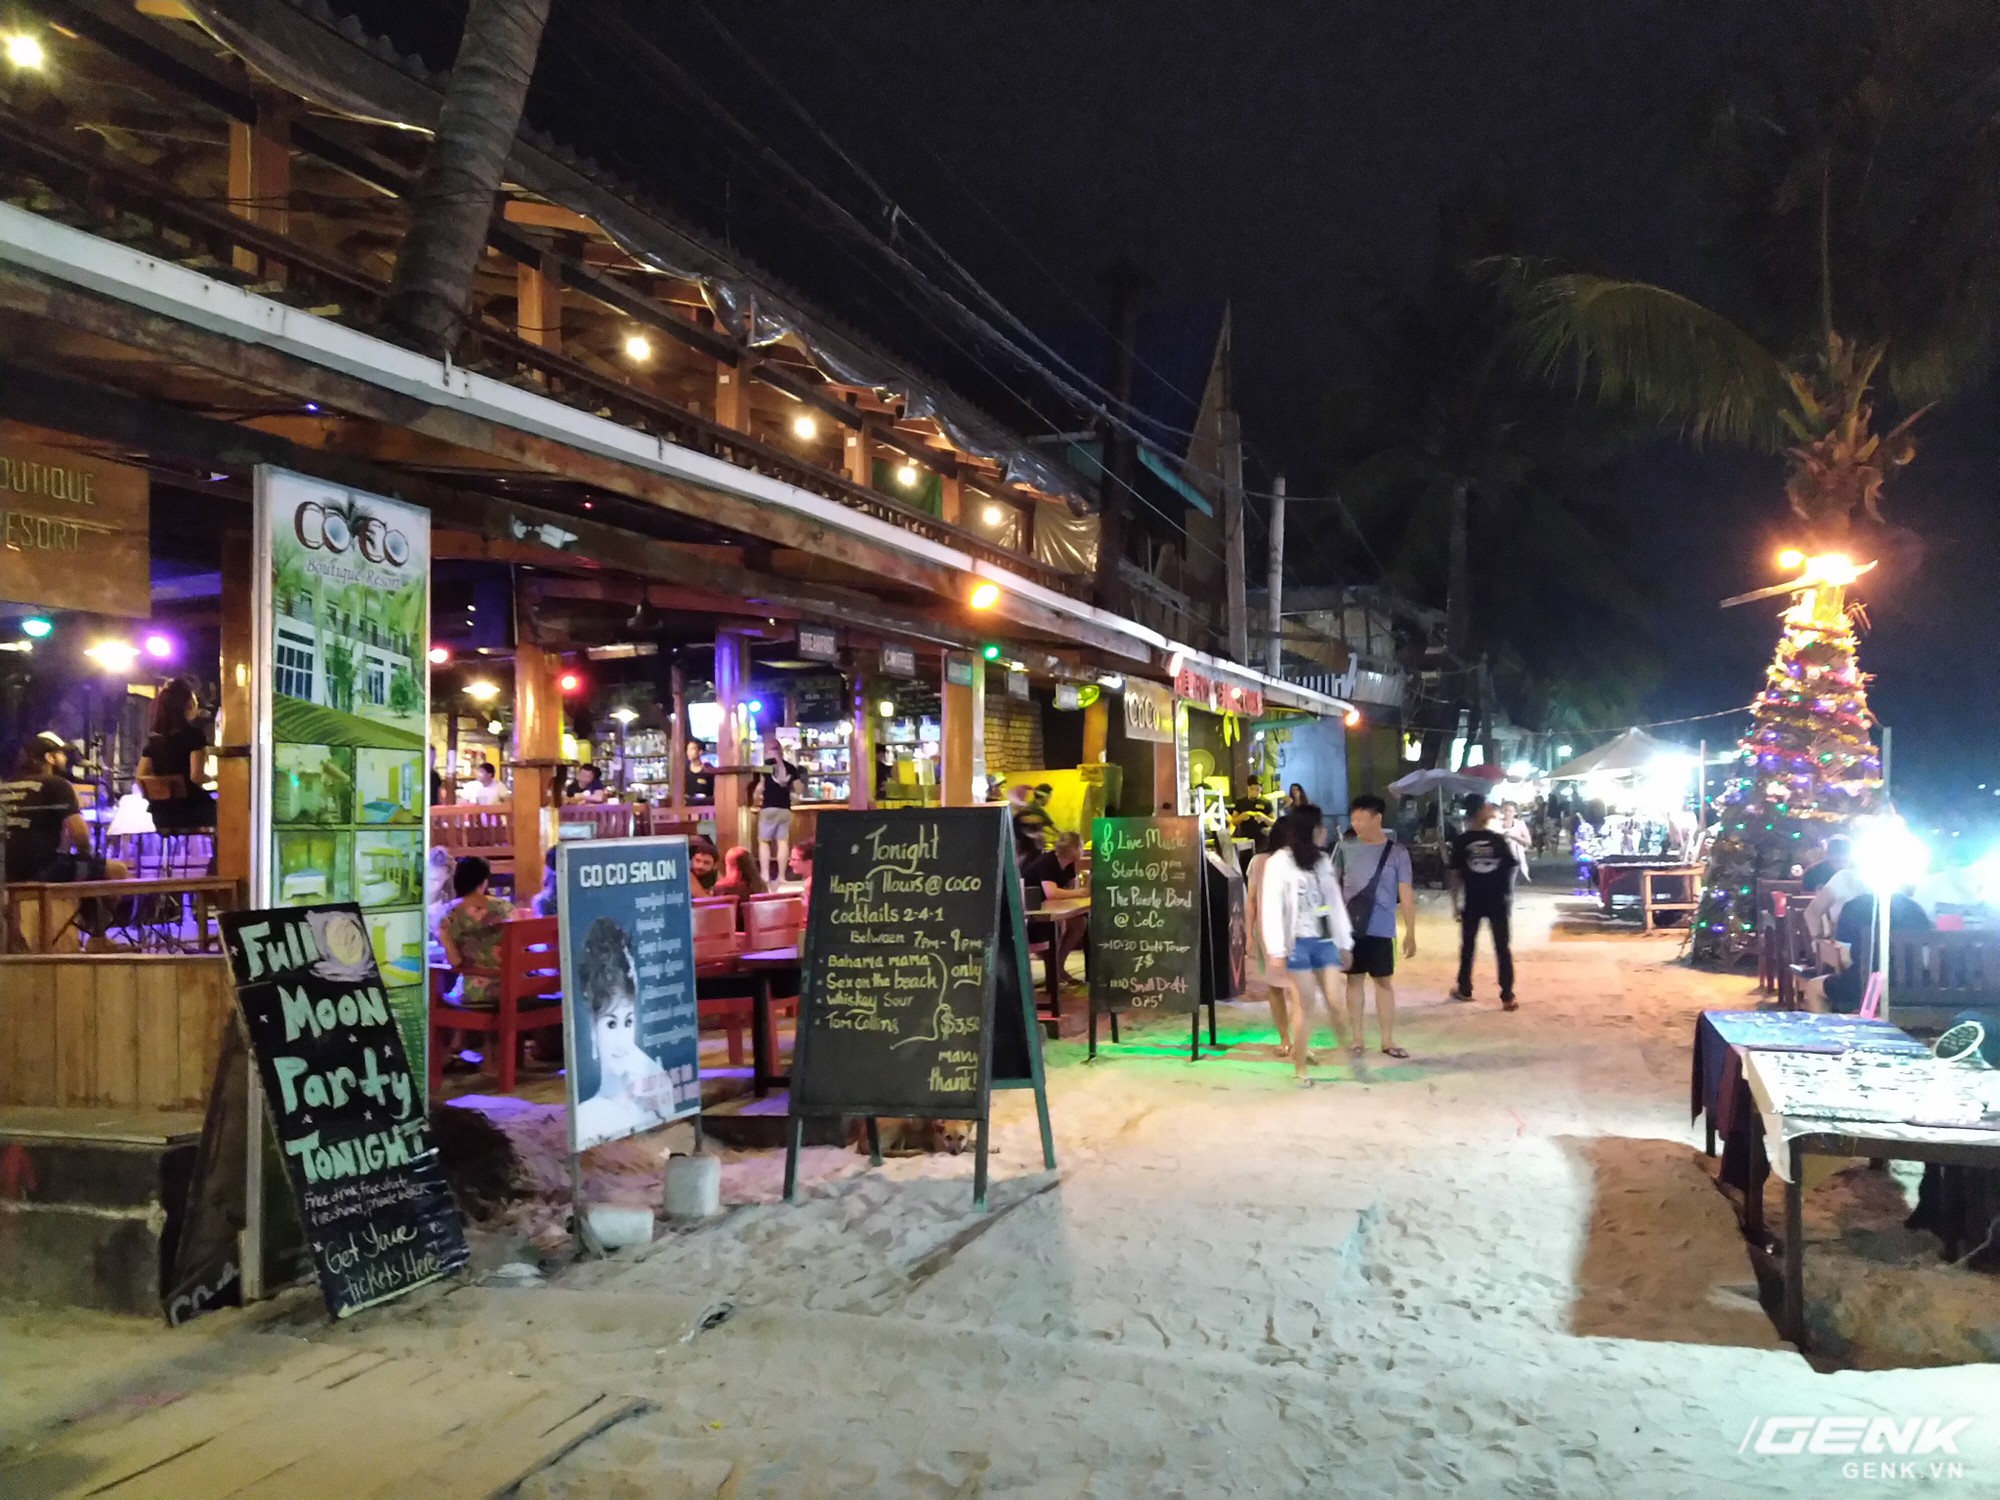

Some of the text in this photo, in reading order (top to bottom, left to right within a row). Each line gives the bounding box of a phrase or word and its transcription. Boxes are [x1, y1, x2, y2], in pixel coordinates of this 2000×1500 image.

[306, 559, 361, 585] Boutique
[865, 823, 940, 880] Tonight
[1117, 828, 1187, 851] Live Music
[580, 859, 677, 888] CO CO SALON
[829, 874, 874, 904] Happy
[1106, 886, 1129, 908] The
[830, 902, 944, 925] Cocktails 2-4-1
[238, 921, 320, 981] Full
[826, 972, 853, 989] Sex
[894, 967, 938, 989] beach
[950, 953, 982, 989] only
[825, 1011, 900, 1034] Tom Collins
[273, 1047, 412, 1120] Party
[323, 1231, 359, 1275] Get
